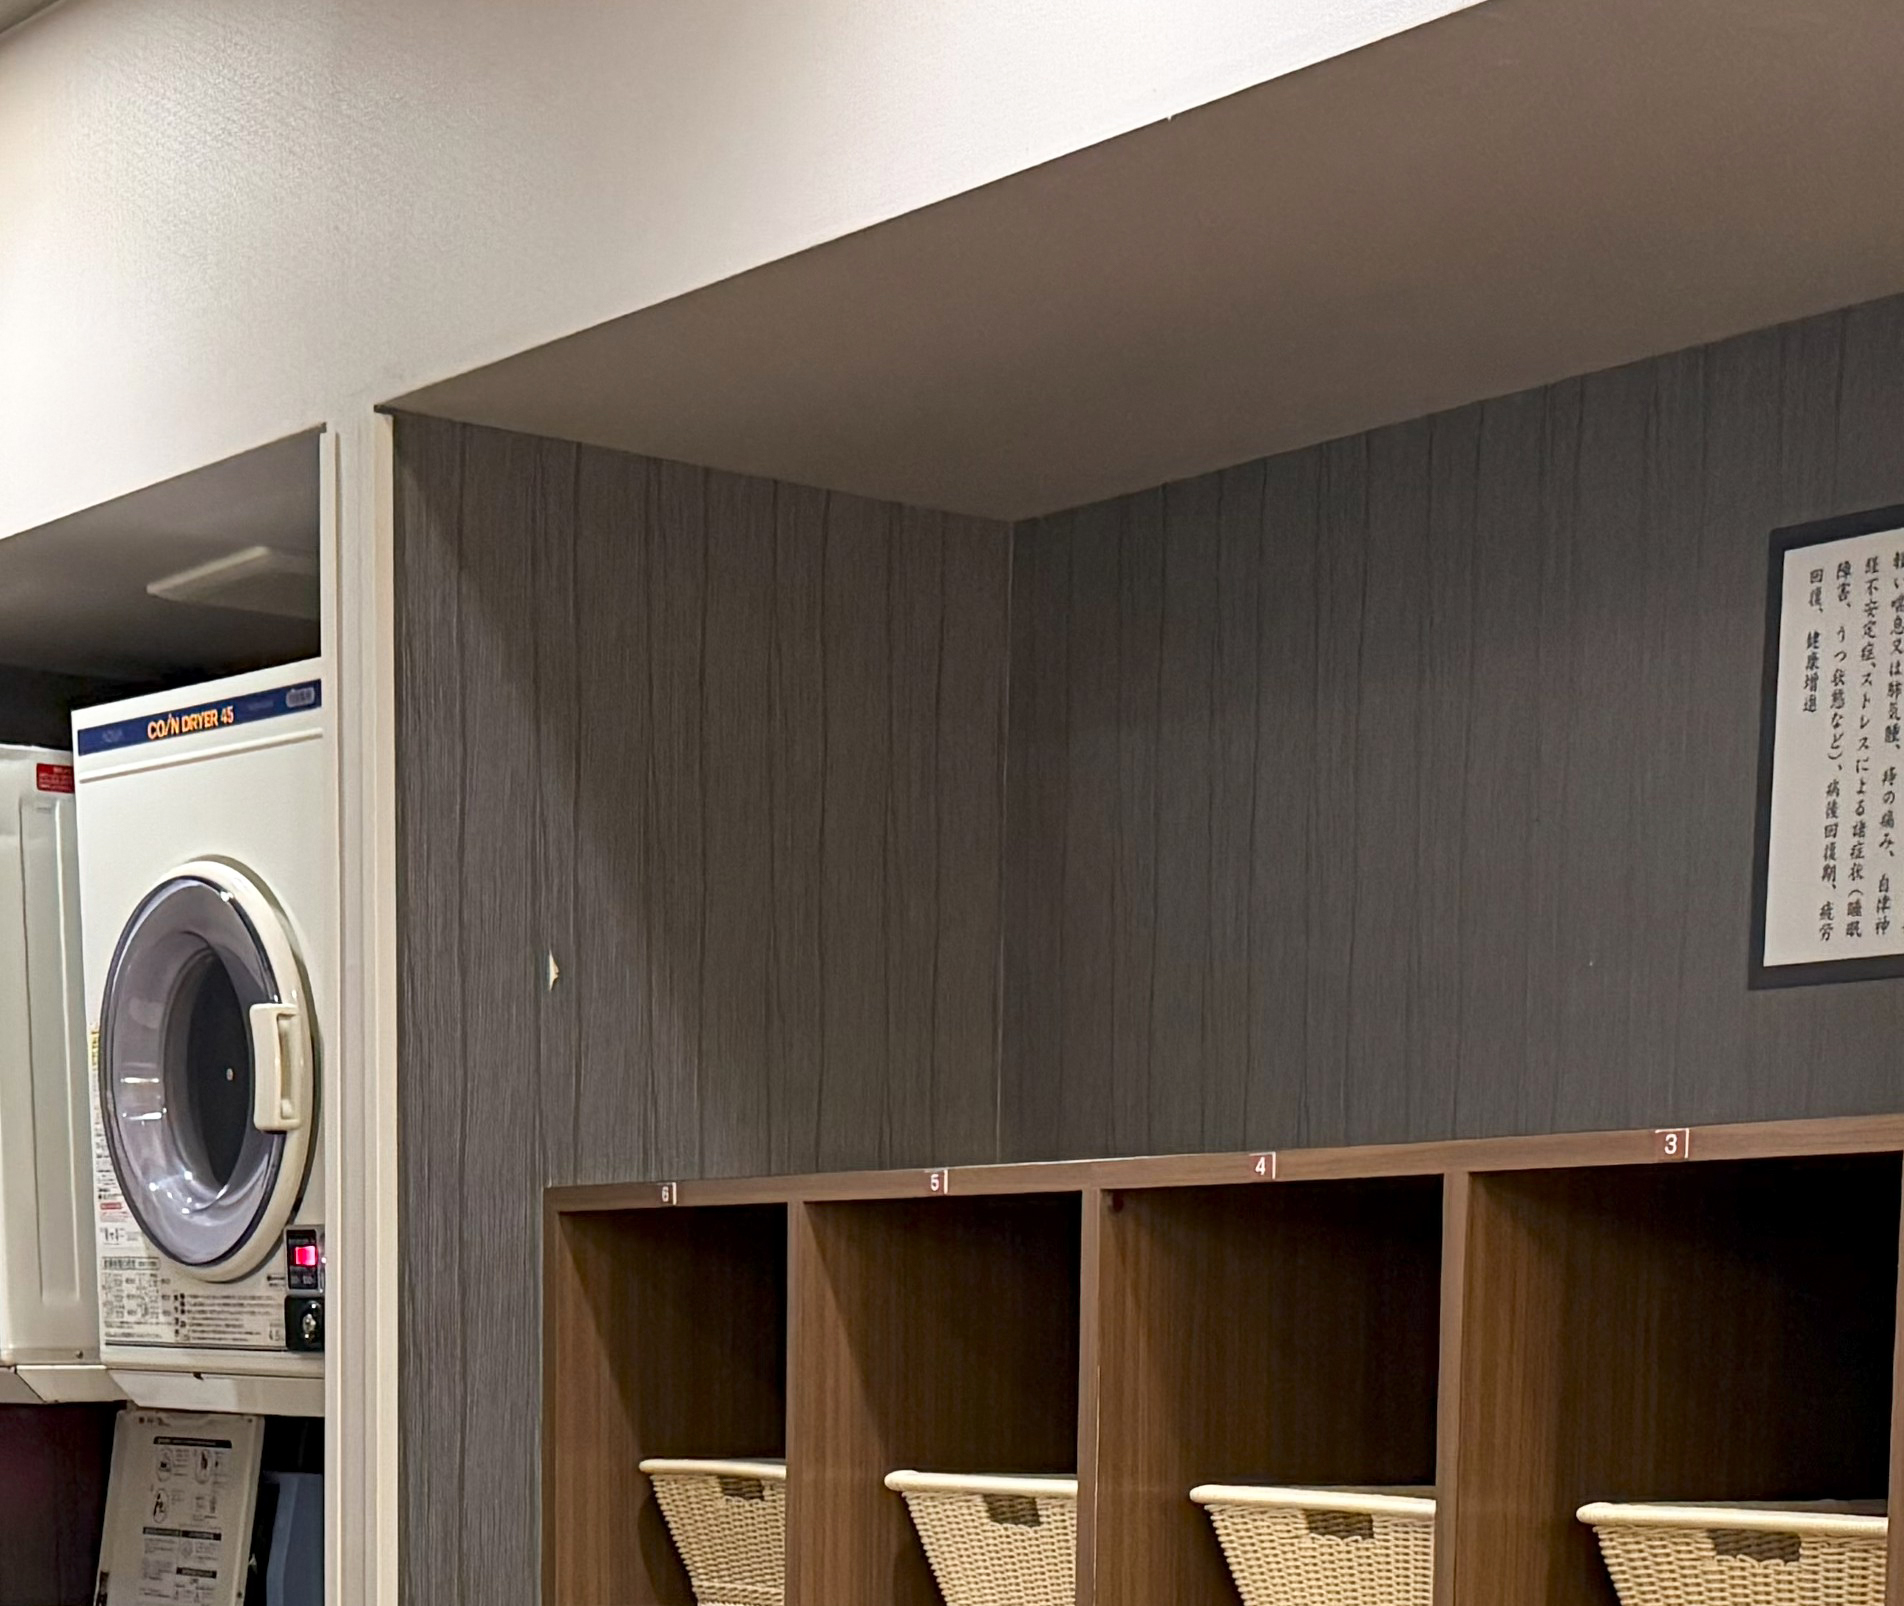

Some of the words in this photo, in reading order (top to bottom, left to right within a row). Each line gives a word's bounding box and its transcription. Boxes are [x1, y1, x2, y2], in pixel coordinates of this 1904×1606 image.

[181, 709, 218, 734] DRYER
[221, 706, 234, 723] 45
[1664, 1134, 1678, 1154] 3
[1255, 1157, 1266, 1175] 4
[930, 1174, 939, 1191] 5
[661, 1186, 669, 1202] 6
